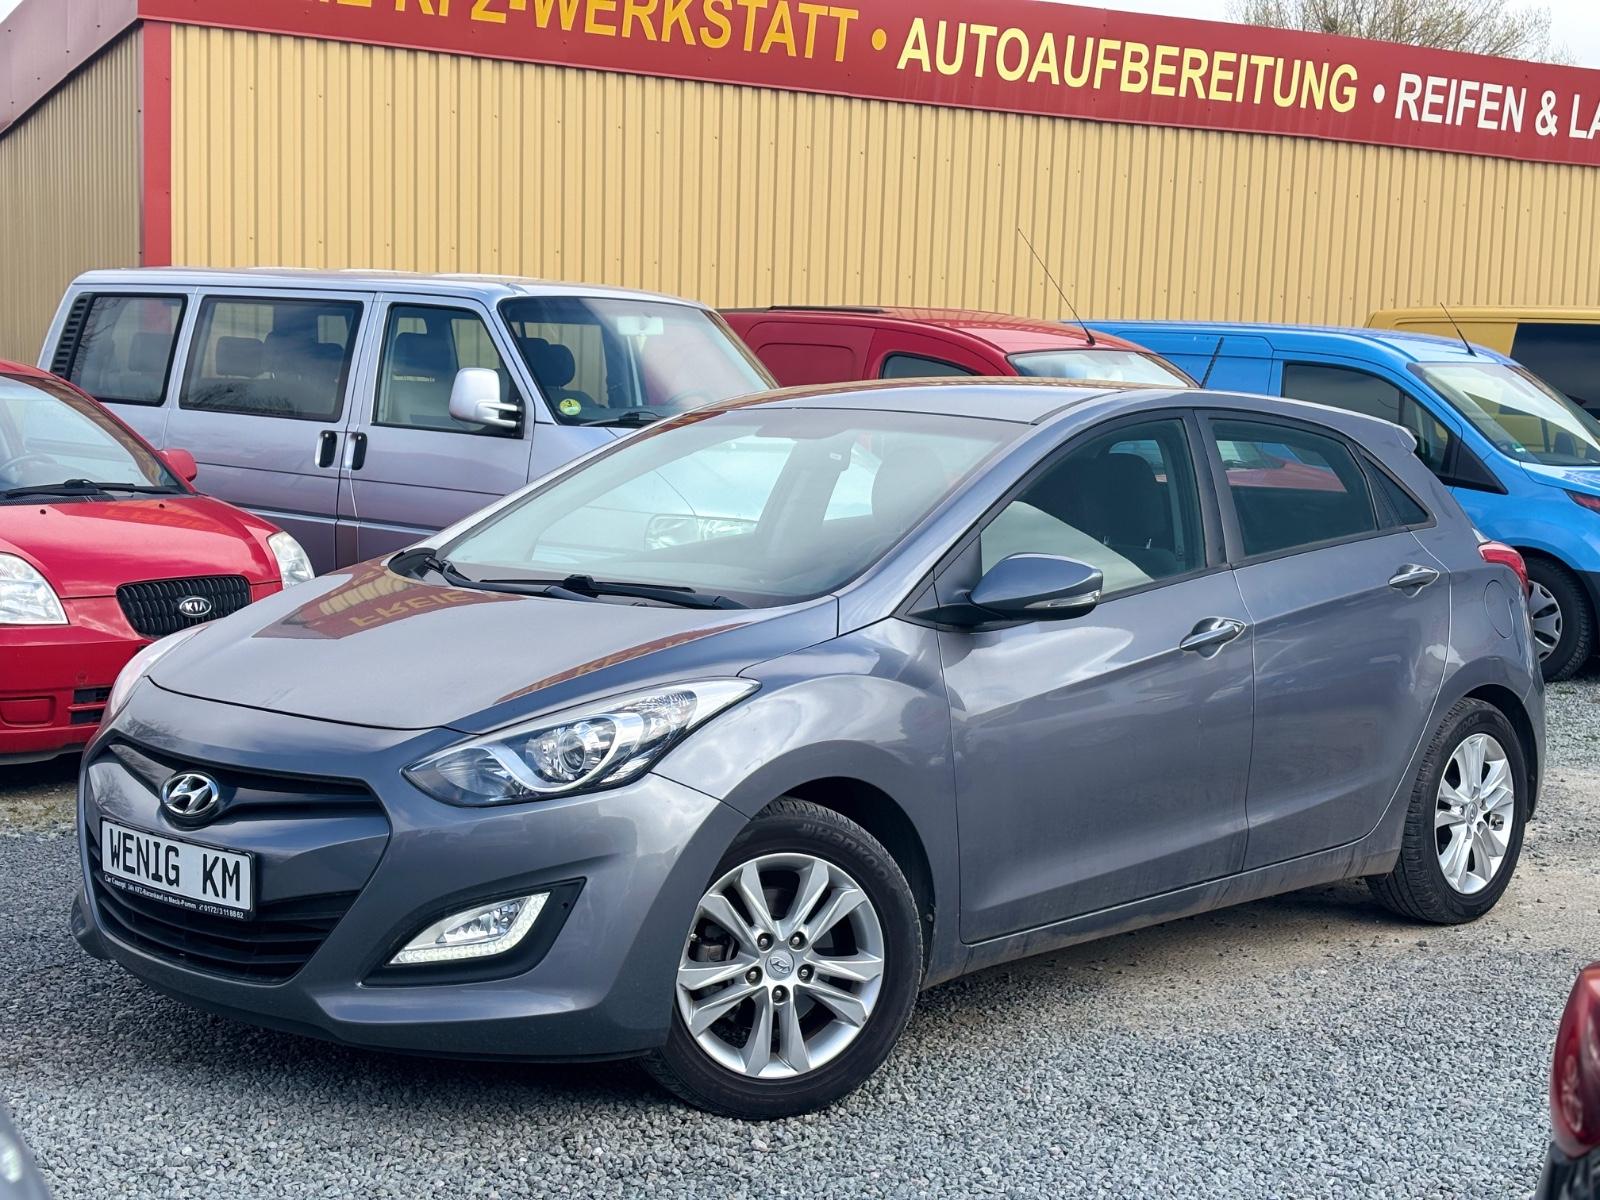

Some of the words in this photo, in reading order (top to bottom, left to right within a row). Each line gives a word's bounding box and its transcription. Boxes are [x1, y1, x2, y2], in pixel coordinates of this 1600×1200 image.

[394, 0, 859, 62] -WERKSTATT
[897, 17, 1358, 113] AUTOAUFBEREITUNG
[1395, 72, 1527, 133] REIFEN
[1535, 90, 1558, 137] &
[184, 601, 207, 612] KIA
[109, 828, 180, 887] WENIG
[202, 853, 241, 902] KM
